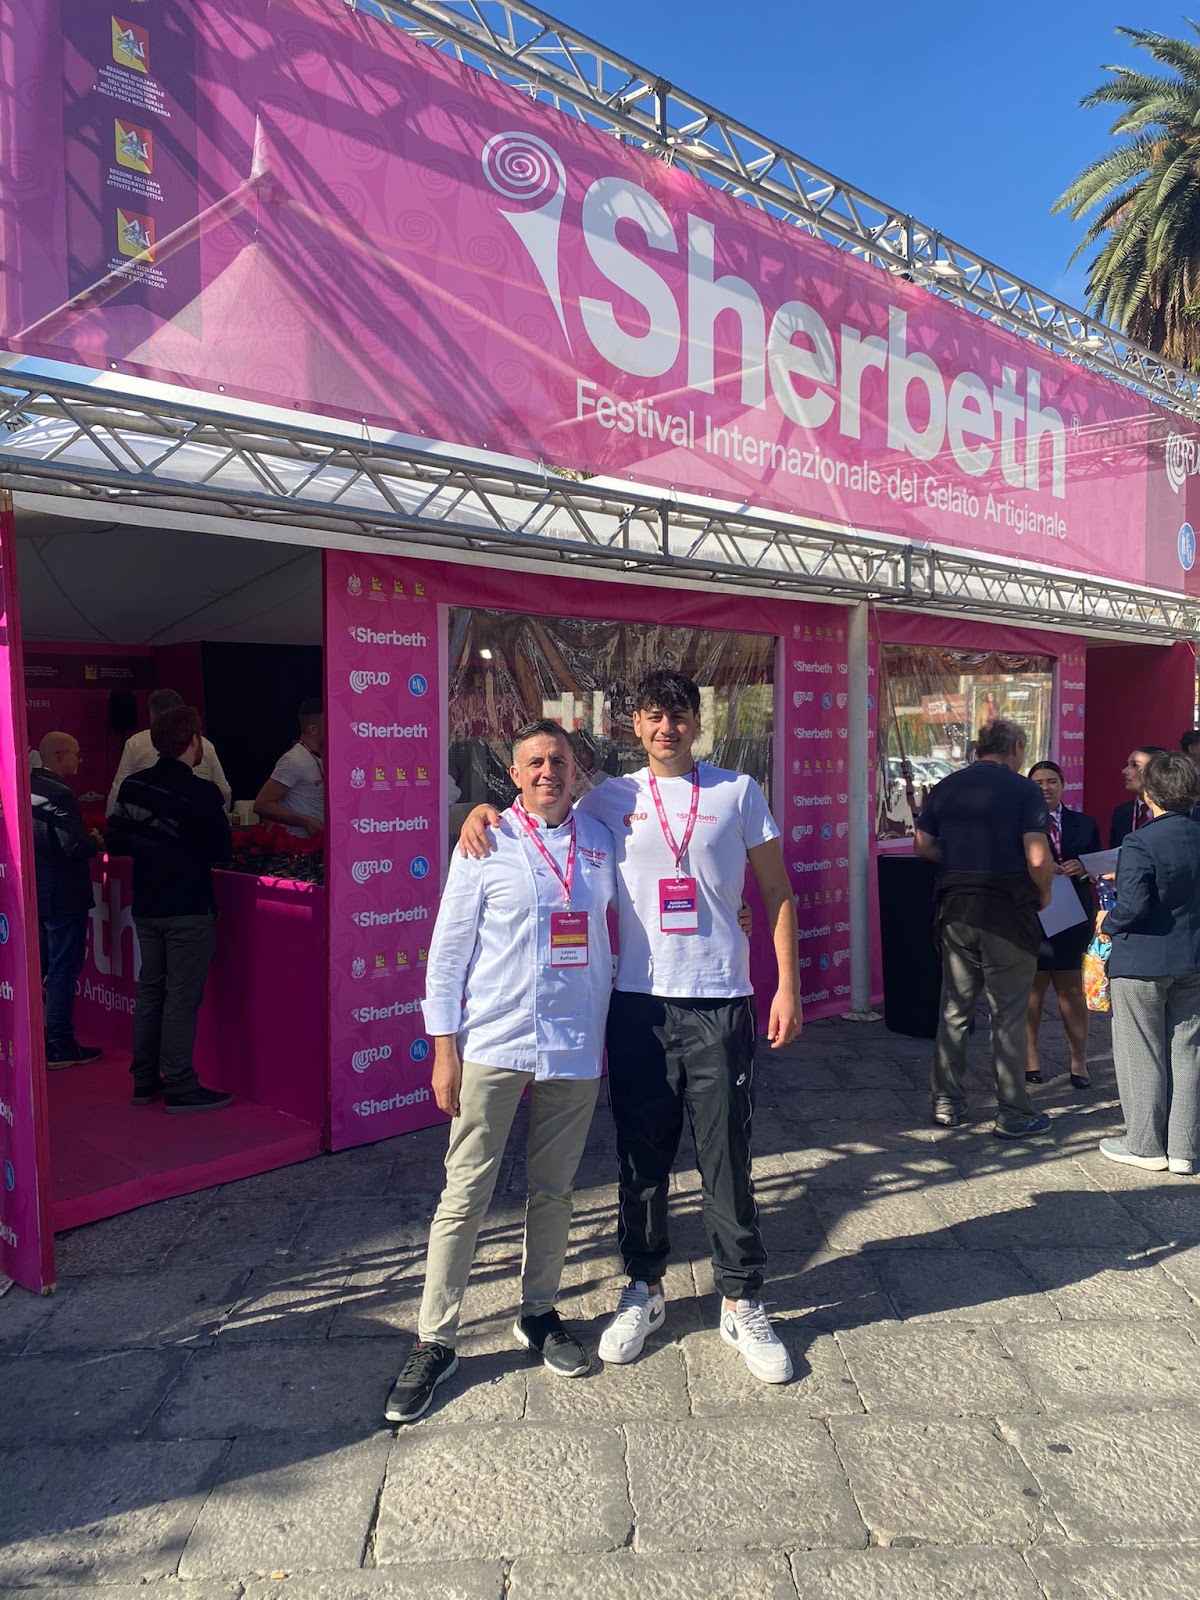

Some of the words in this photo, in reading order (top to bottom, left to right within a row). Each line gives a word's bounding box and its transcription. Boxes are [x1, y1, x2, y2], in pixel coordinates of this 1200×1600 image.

[98, 69, 136, 87] ASSESSORATO
[106, 65, 129, 79] REGIONE
[131, 72, 158, 88] SICILIANA
[97, 86, 114, 97] DELLA
[115, 92, 131, 103] PESCA
[100, 81, 117, 92] DELLO
[108, 174, 145, 189] ASSESSORATO
[146, 185, 162, 195] DELLE
[109, 168, 133, 180] REGIONE
[134, 175, 161, 188] SICILIANA
[132, 187, 164, 202] PRODUTTIVE
[136, 264, 163, 276] SICILIANA
[145, 272, 168, 284] TURISMO
[578, 176, 1066, 501] Sherbeth
[577, 378, 695, 449] Festival
[705, 415, 881, 495] Internazionale
[887, 468, 918, 504] del
[924, 476, 979, 519] Gelato
[984, 493, 1066, 540] Artigianale
[356, 627, 427, 647] Sherbeth
[796, 660, 833, 674] Sherbeth
[357, 722, 429, 738] Sherbeth
[796, 727, 833, 741] Sherbeth
[796, 793, 832, 806] Sherbeth
[359, 815, 429, 834] Sherbeth
[795, 859, 832, 873] Sherbeth
[359, 905, 428, 927] Sherbeth
[84, 978, 137, 1015] Artigiana
[800, 989, 830, 1004] herbeth
[359, 997, 422, 1023] Sherbet
[360, 1087, 430, 1117] Sherbeth
